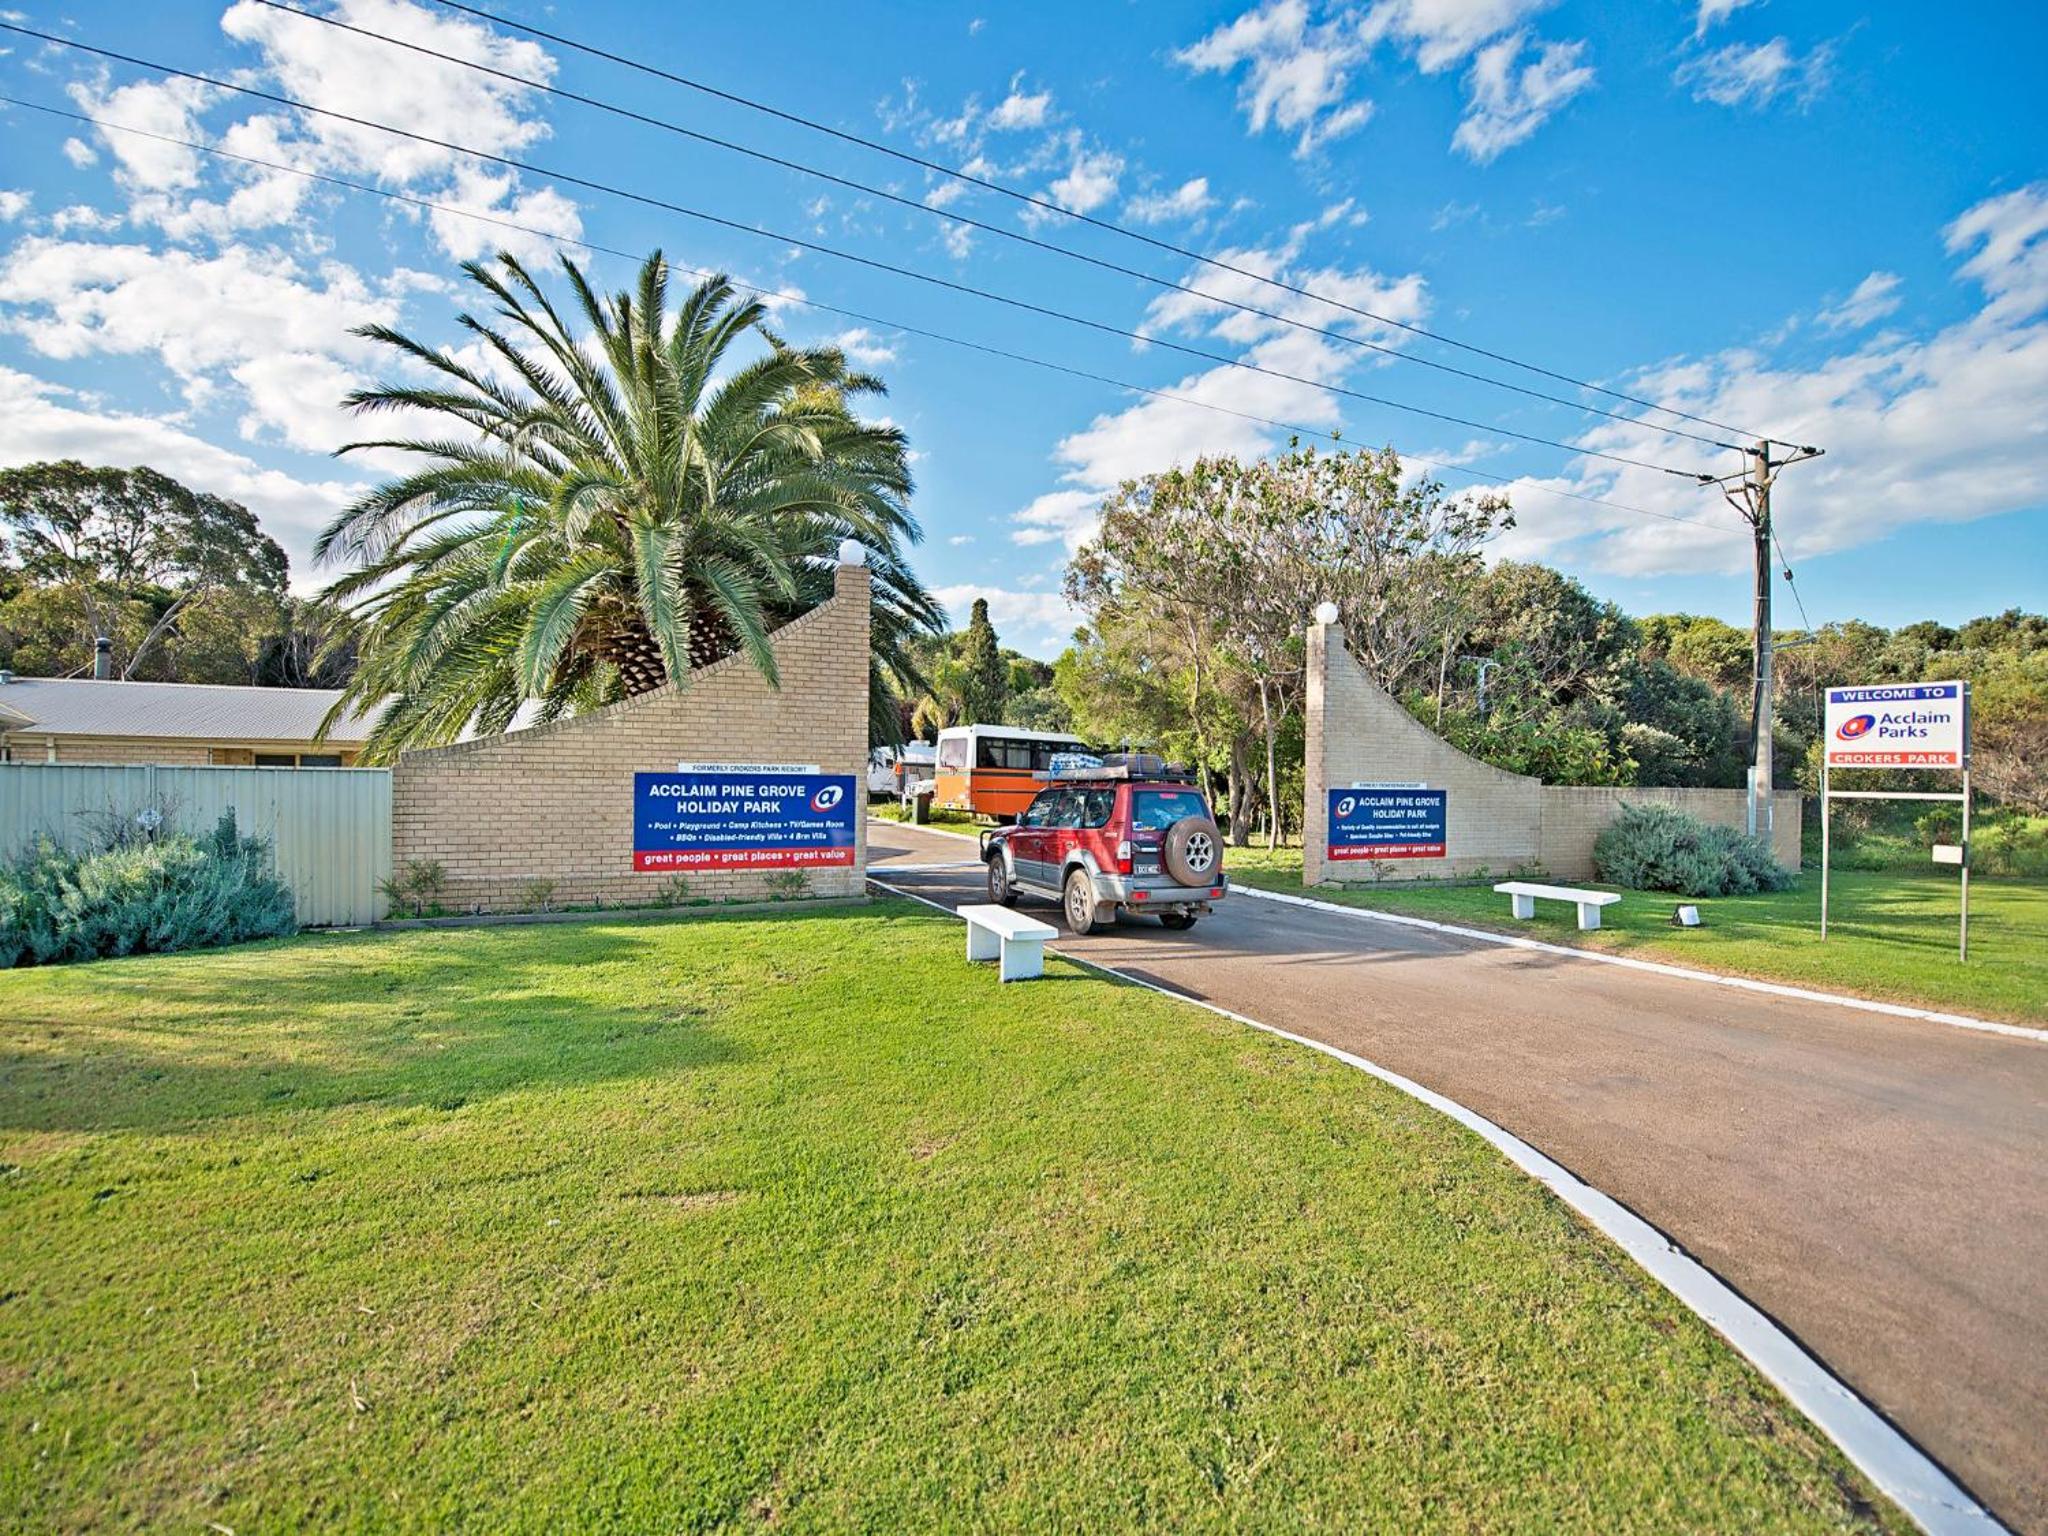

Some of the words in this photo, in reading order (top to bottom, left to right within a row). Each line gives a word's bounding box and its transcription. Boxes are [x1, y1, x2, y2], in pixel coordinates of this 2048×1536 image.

[1842, 689, 1916, 701] WELCOME
[1922, 688, 1945, 698] TO
[1880, 711, 1950, 724] Acclaim
[1879, 726, 1928, 738] Parks
[1835, 754, 1902, 764] CROKERS
[1908, 754, 1950, 763] PARK
[649, 784, 717, 797] ACCLAIM
[722, 785, 755, 797] PINE
[759, 785, 806, 797] GROVE
[677, 801, 738, 813] HOLIDAY
[744, 801, 781, 813] PARK
[1359, 797, 1394, 806] ACCLAIM
[1396, 797, 1413, 806] PINE
[1415, 797, 1440, 806] GROVE
[1373, 809, 1405, 818] HOLIDAY
[1407, 809, 1427, 818] PARK
[653, 822, 671, 830] Pool
[679, 822, 721, 831] Playground
[728, 821, 749, 830] Camp
[750, 821, 782, 829] Kitchens
[825, 820, 845, 828] Room
[675, 834, 697, 842] BBQs
[1334, 847, 1349, 856] great
[1350, 846, 1369, 855] people
[1374, 845, 1388, 854] great
[1412, 845, 1426, 854] great
[645, 853, 673, 865] great
[675, 852, 711, 864] people
[721, 852, 748, 863] great
[751, 850, 783, 862] places
[793, 850, 818, 861] great
[820, 849, 846, 859] value
